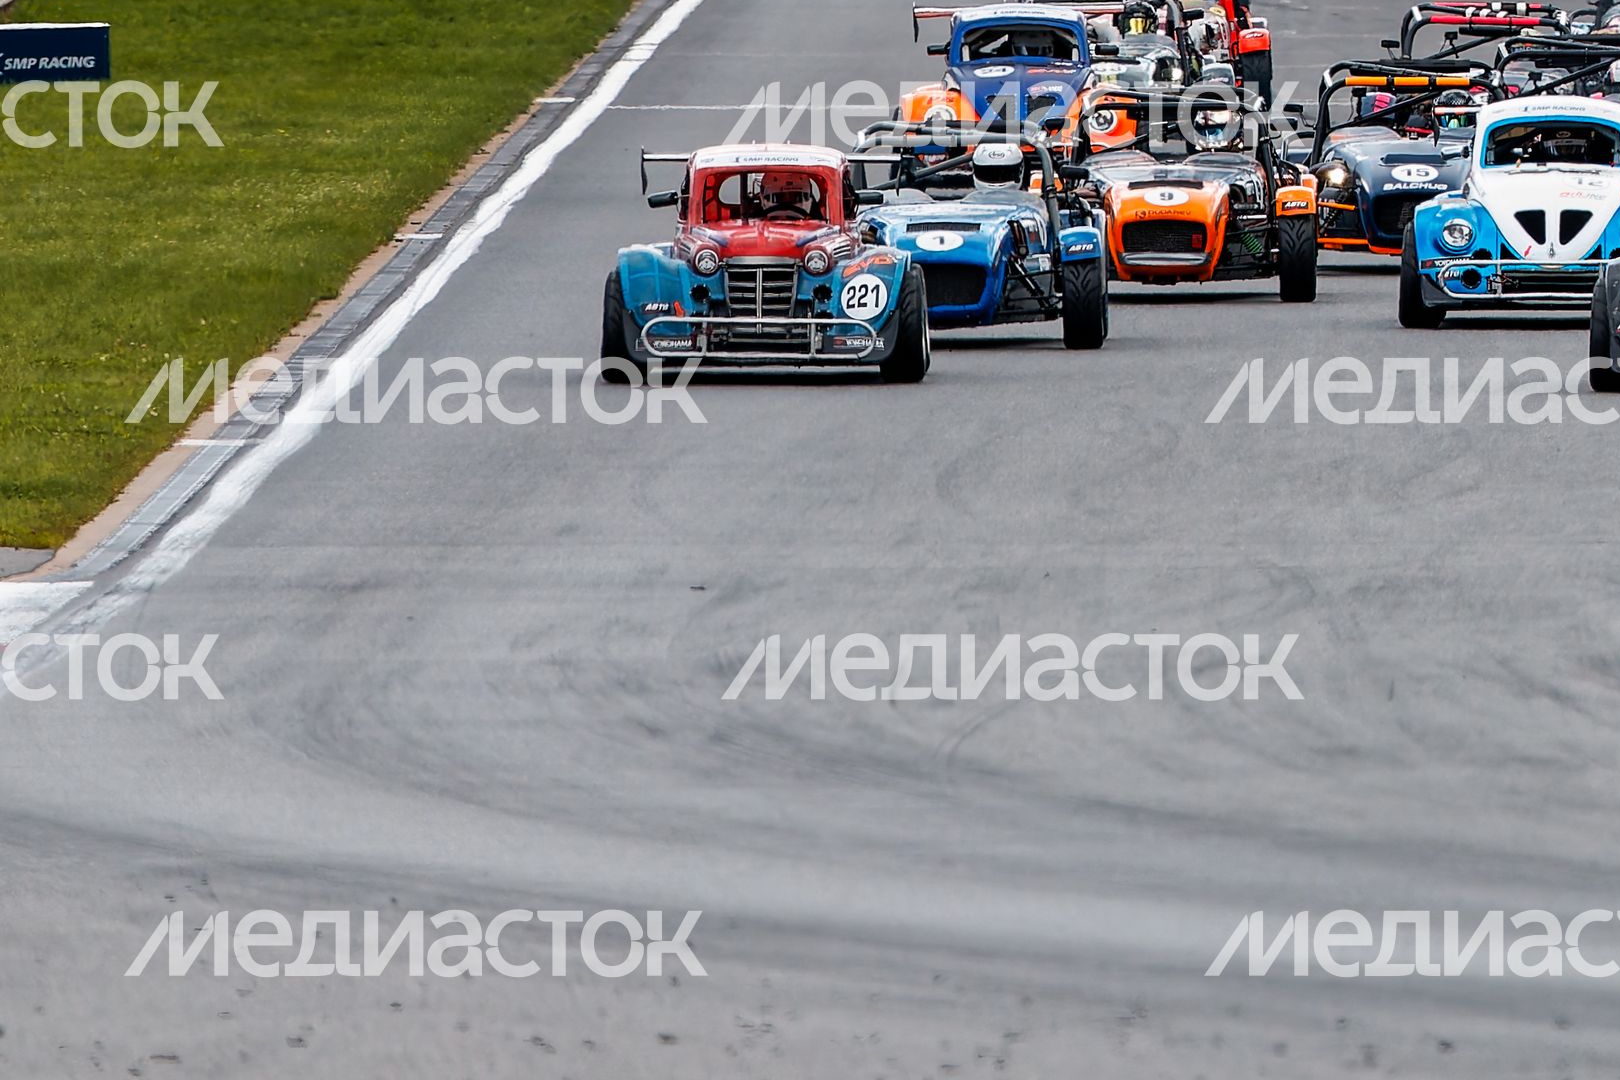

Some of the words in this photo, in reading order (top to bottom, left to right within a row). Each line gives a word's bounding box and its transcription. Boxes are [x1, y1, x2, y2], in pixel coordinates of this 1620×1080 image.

[4, 57, 37, 71] SMP
[38, 56, 97, 70] RACING
[1401, 168, 1430, 177] 15
[1383, 182, 1448, 191] BALCHUG
[1159, 192, 1174, 201] 9
[846, 284, 880, 309] 221
